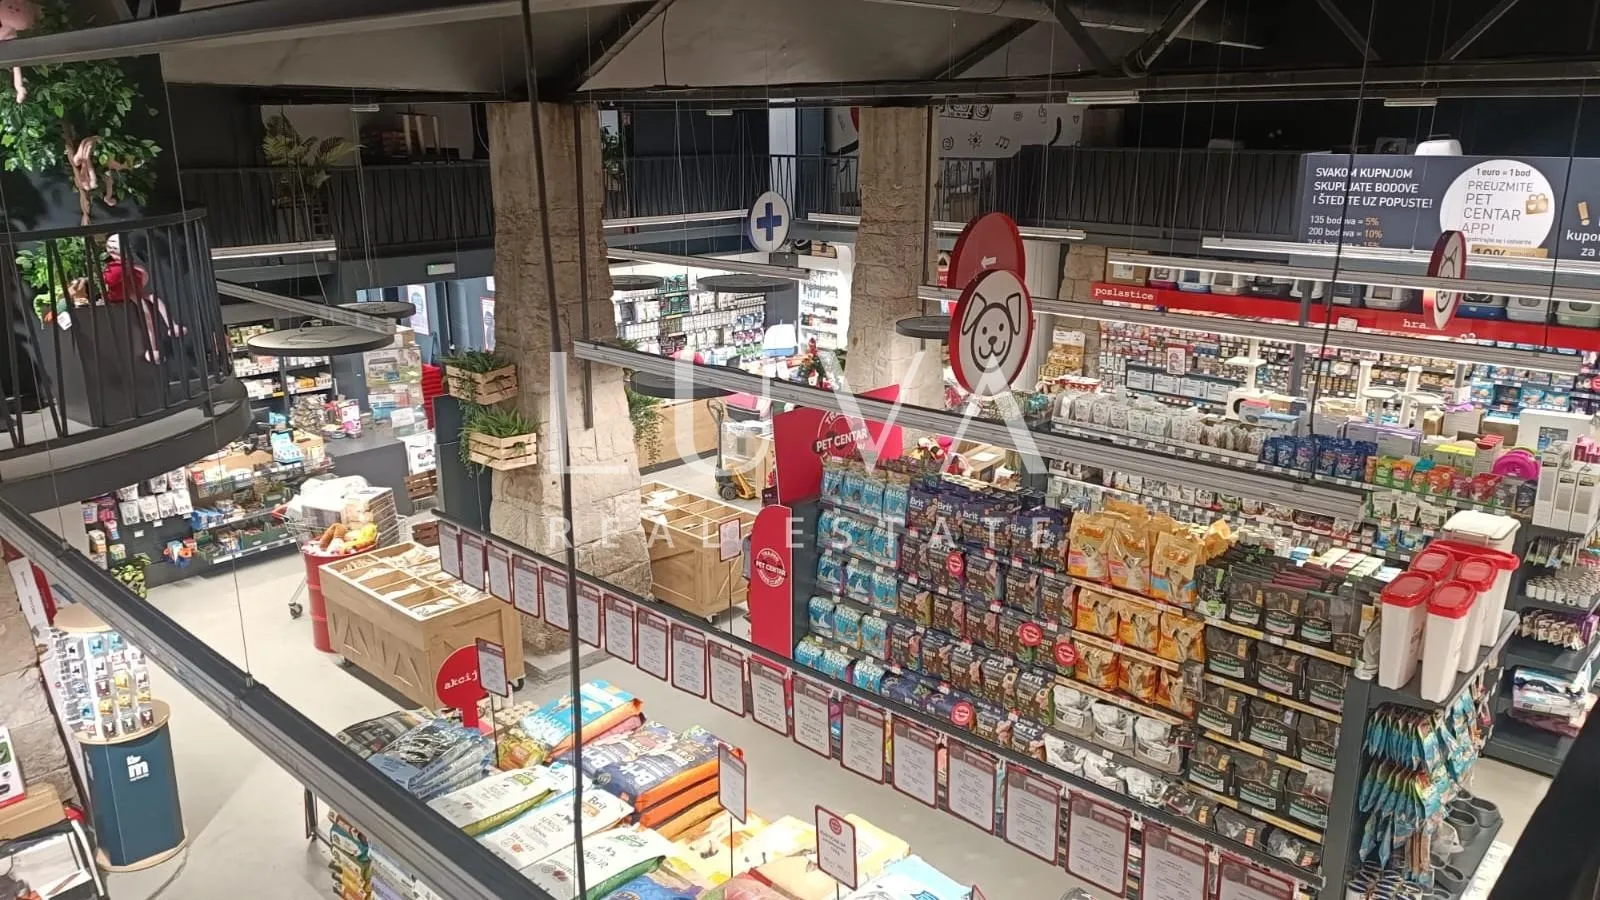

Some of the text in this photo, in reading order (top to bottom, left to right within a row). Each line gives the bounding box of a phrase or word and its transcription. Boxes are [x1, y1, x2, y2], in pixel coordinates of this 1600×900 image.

[1360, 168, 1413, 178] KUPNJOM
[1375, 183, 1420, 193] BODOVE
[1467, 181, 1534, 192] PREUZMITE
[1318, 193, 1360, 206] ŠTEDTE
[1362, 197, 1377, 206] UZ
[1379, 198, 1433, 208] POPUSTE!
[1465, 193, 1493, 205] PET
[1463, 207, 1521, 220] CENTAR
[1310, 215, 1325, 224] 135
[1365, 217, 1379, 226] 5%
[1308, 227, 1323, 235] 200
[1364, 230, 1383, 239] 10%
[1462, 222, 1495, 235] APP!
[1581, 248, 1595, 257] za
[1094, 286, 1154, 300] poslastice
[816, 428, 868, 452] PET CENTAR
[909, 496, 923, 508] Brit
[937, 502, 952, 513] Brit
[1011, 524, 1027, 535] Brit
[444, 670, 478, 690] akcij
[587, 796, 608, 810] Brit
